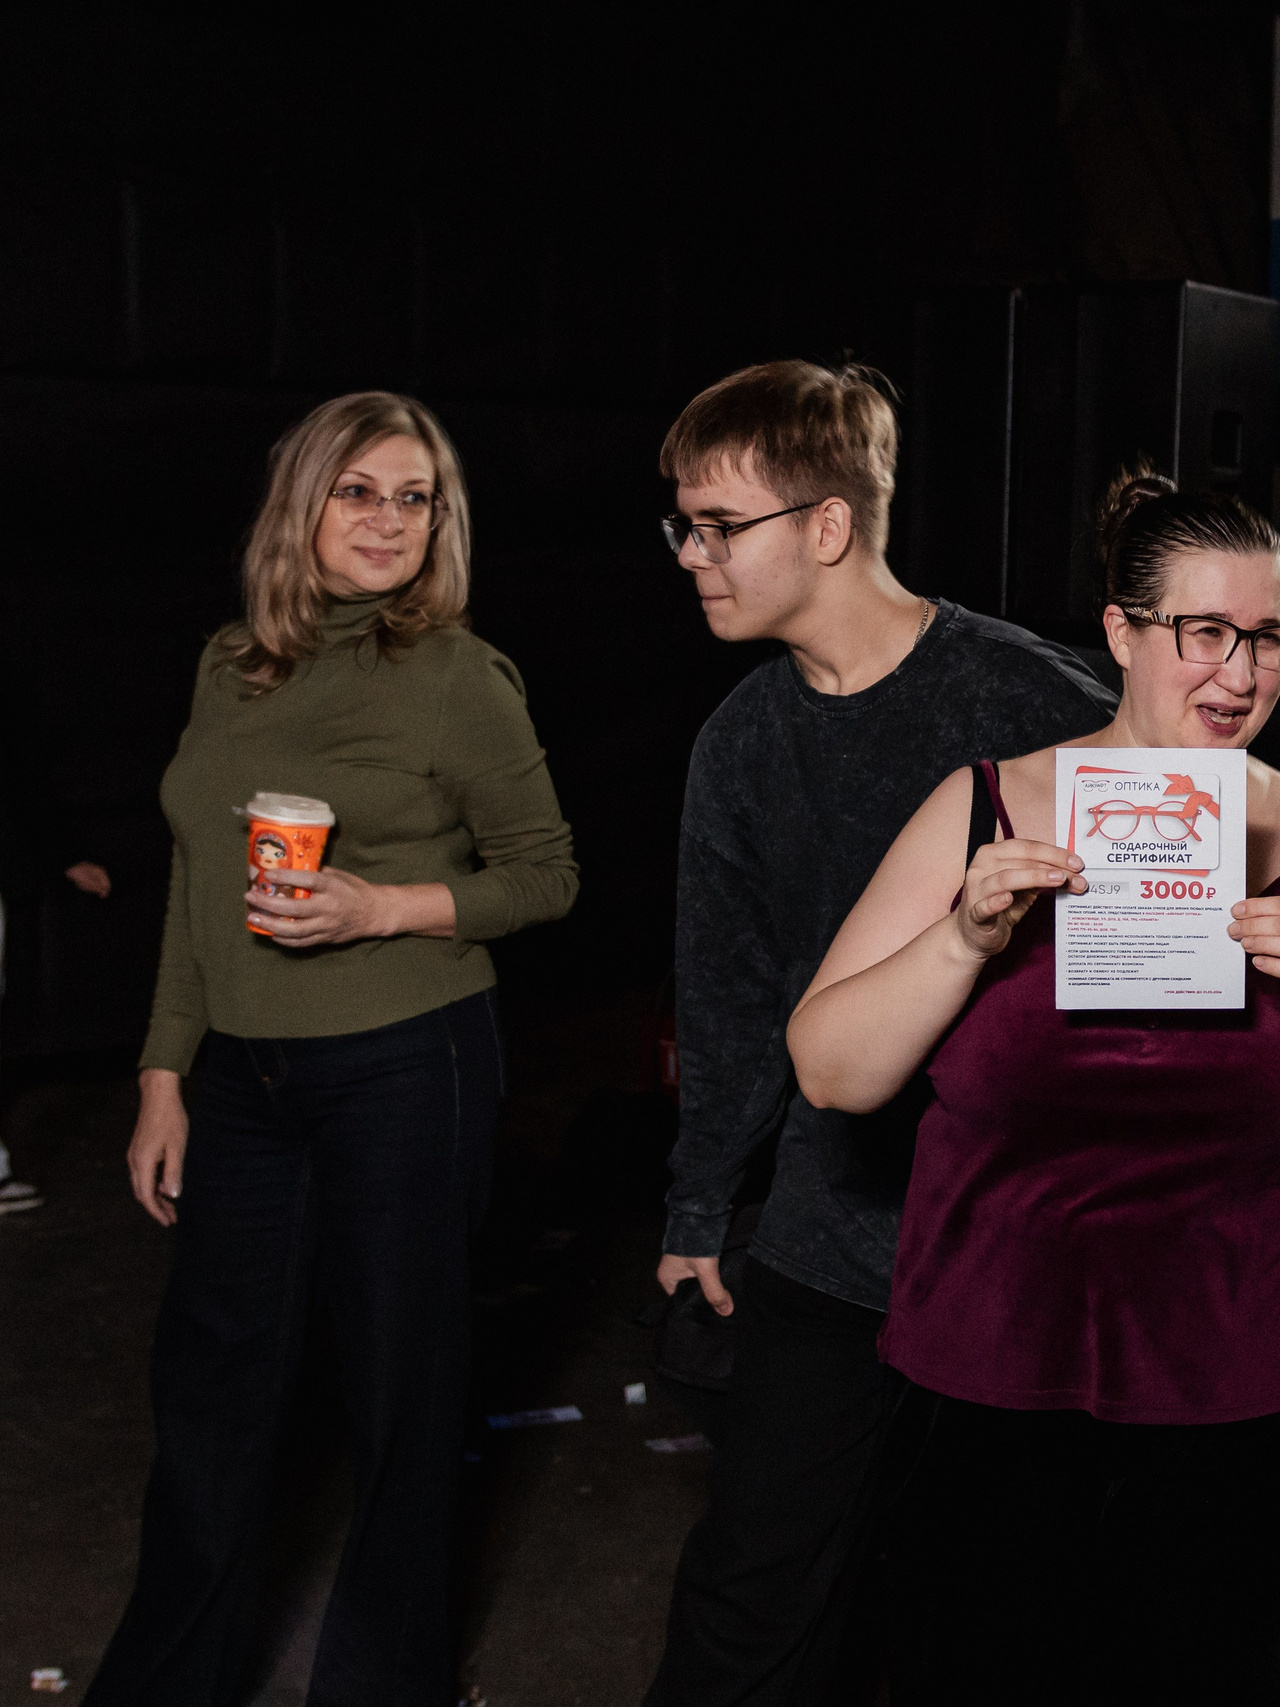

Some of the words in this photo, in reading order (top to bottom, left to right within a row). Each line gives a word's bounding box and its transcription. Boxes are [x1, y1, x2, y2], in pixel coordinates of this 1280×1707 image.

[1114, 781, 1161, 791] ОПТИКА
[1111, 841, 1187, 852] ПОДАРОЧНЫЙ
[1106, 853, 1193, 864] СЕРТИФИКАТ
[1090, 884, 1121, 895] 4SJ9
